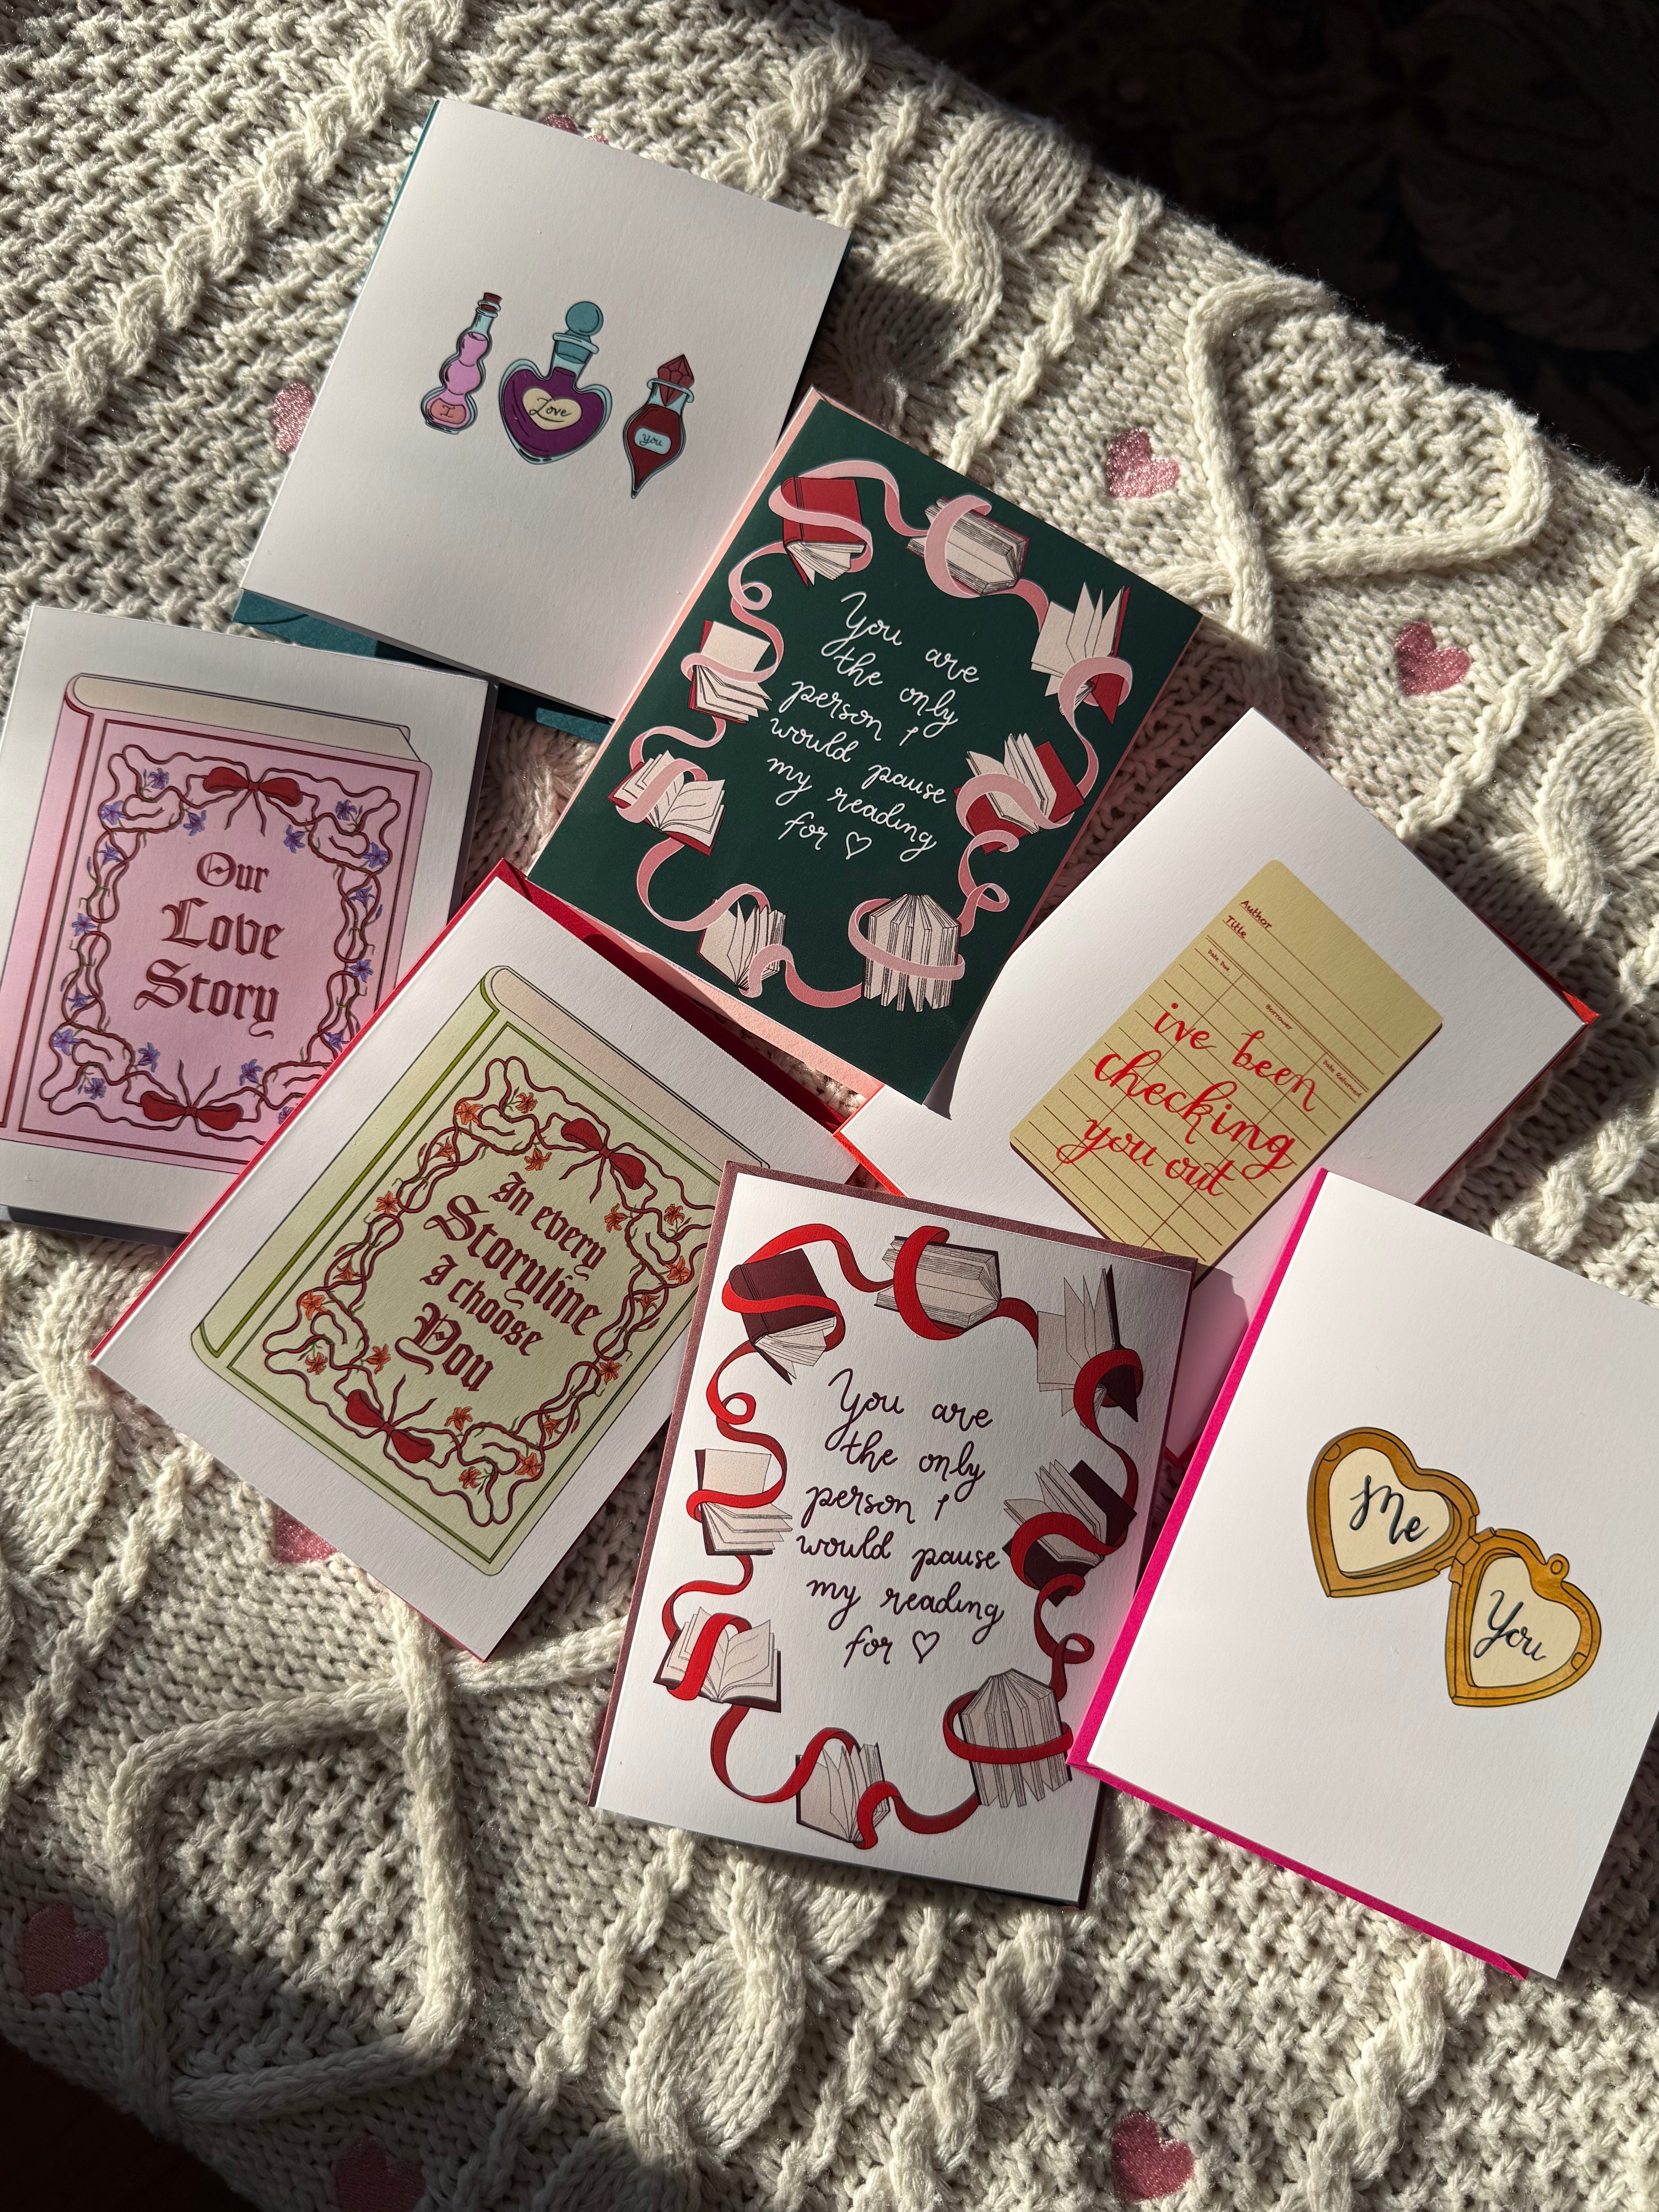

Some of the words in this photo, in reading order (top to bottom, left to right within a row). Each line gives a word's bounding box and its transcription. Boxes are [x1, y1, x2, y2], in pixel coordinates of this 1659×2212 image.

[441, 404, 455, 417] I
[529, 398, 571, 423] Love
[639, 432, 663, 447] you
[821, 592, 902, 657] You
[925, 649, 979, 683] are
[779, 681, 881, 741] person
[834, 648, 883, 686] the
[899, 687, 958, 738] only
[771, 718, 858, 763] would
[861, 765, 947, 803] pause
[767, 758, 812, 806] my
[827, 787, 937, 862] reading
[778, 812, 828, 851] for
[197, 852, 270, 893] Our
[162, 898, 285, 960] Love
[1226, 915, 1247, 939] Title
[1241, 900, 1272, 928] Author
[1208, 949, 1219, 961] Date
[1220, 961, 1230, 972] Due
[134, 959, 280, 1039] Story
[1265, 1004, 1292, 1030] Borrower
[1232, 1030, 1316, 1112] been
[1323, 1060, 1335, 1073] Date
[1336, 1073, 1361, 1098] Returned
[1094, 1049, 1297, 1180] checking
[1056, 1119, 1158, 1167] you
[1165, 1157, 1235, 1197] out
[488, 1171, 534, 1216] In
[530, 1206, 607, 1281] every
[423, 1195, 602, 1336] Storyline
[420, 1254, 459, 1286] I
[448, 1278, 544, 1356] choose
[395, 1302, 494, 1391] You
[825, 1368, 904, 1450] You
[932, 1401, 993, 1431] are
[840, 1430, 898, 1472] the
[918, 1441, 985, 1502] only
[801, 1486, 915, 1528] person
[1349, 1475, 1429, 1544] Me
[796, 1525, 894, 1559] would
[912, 1547, 1000, 1581] pause
[806, 1579, 861, 1630] my
[880, 1581, 1004, 1644] reading
[843, 1624, 893, 1668] for
[1473, 1590, 1546, 1661] You
